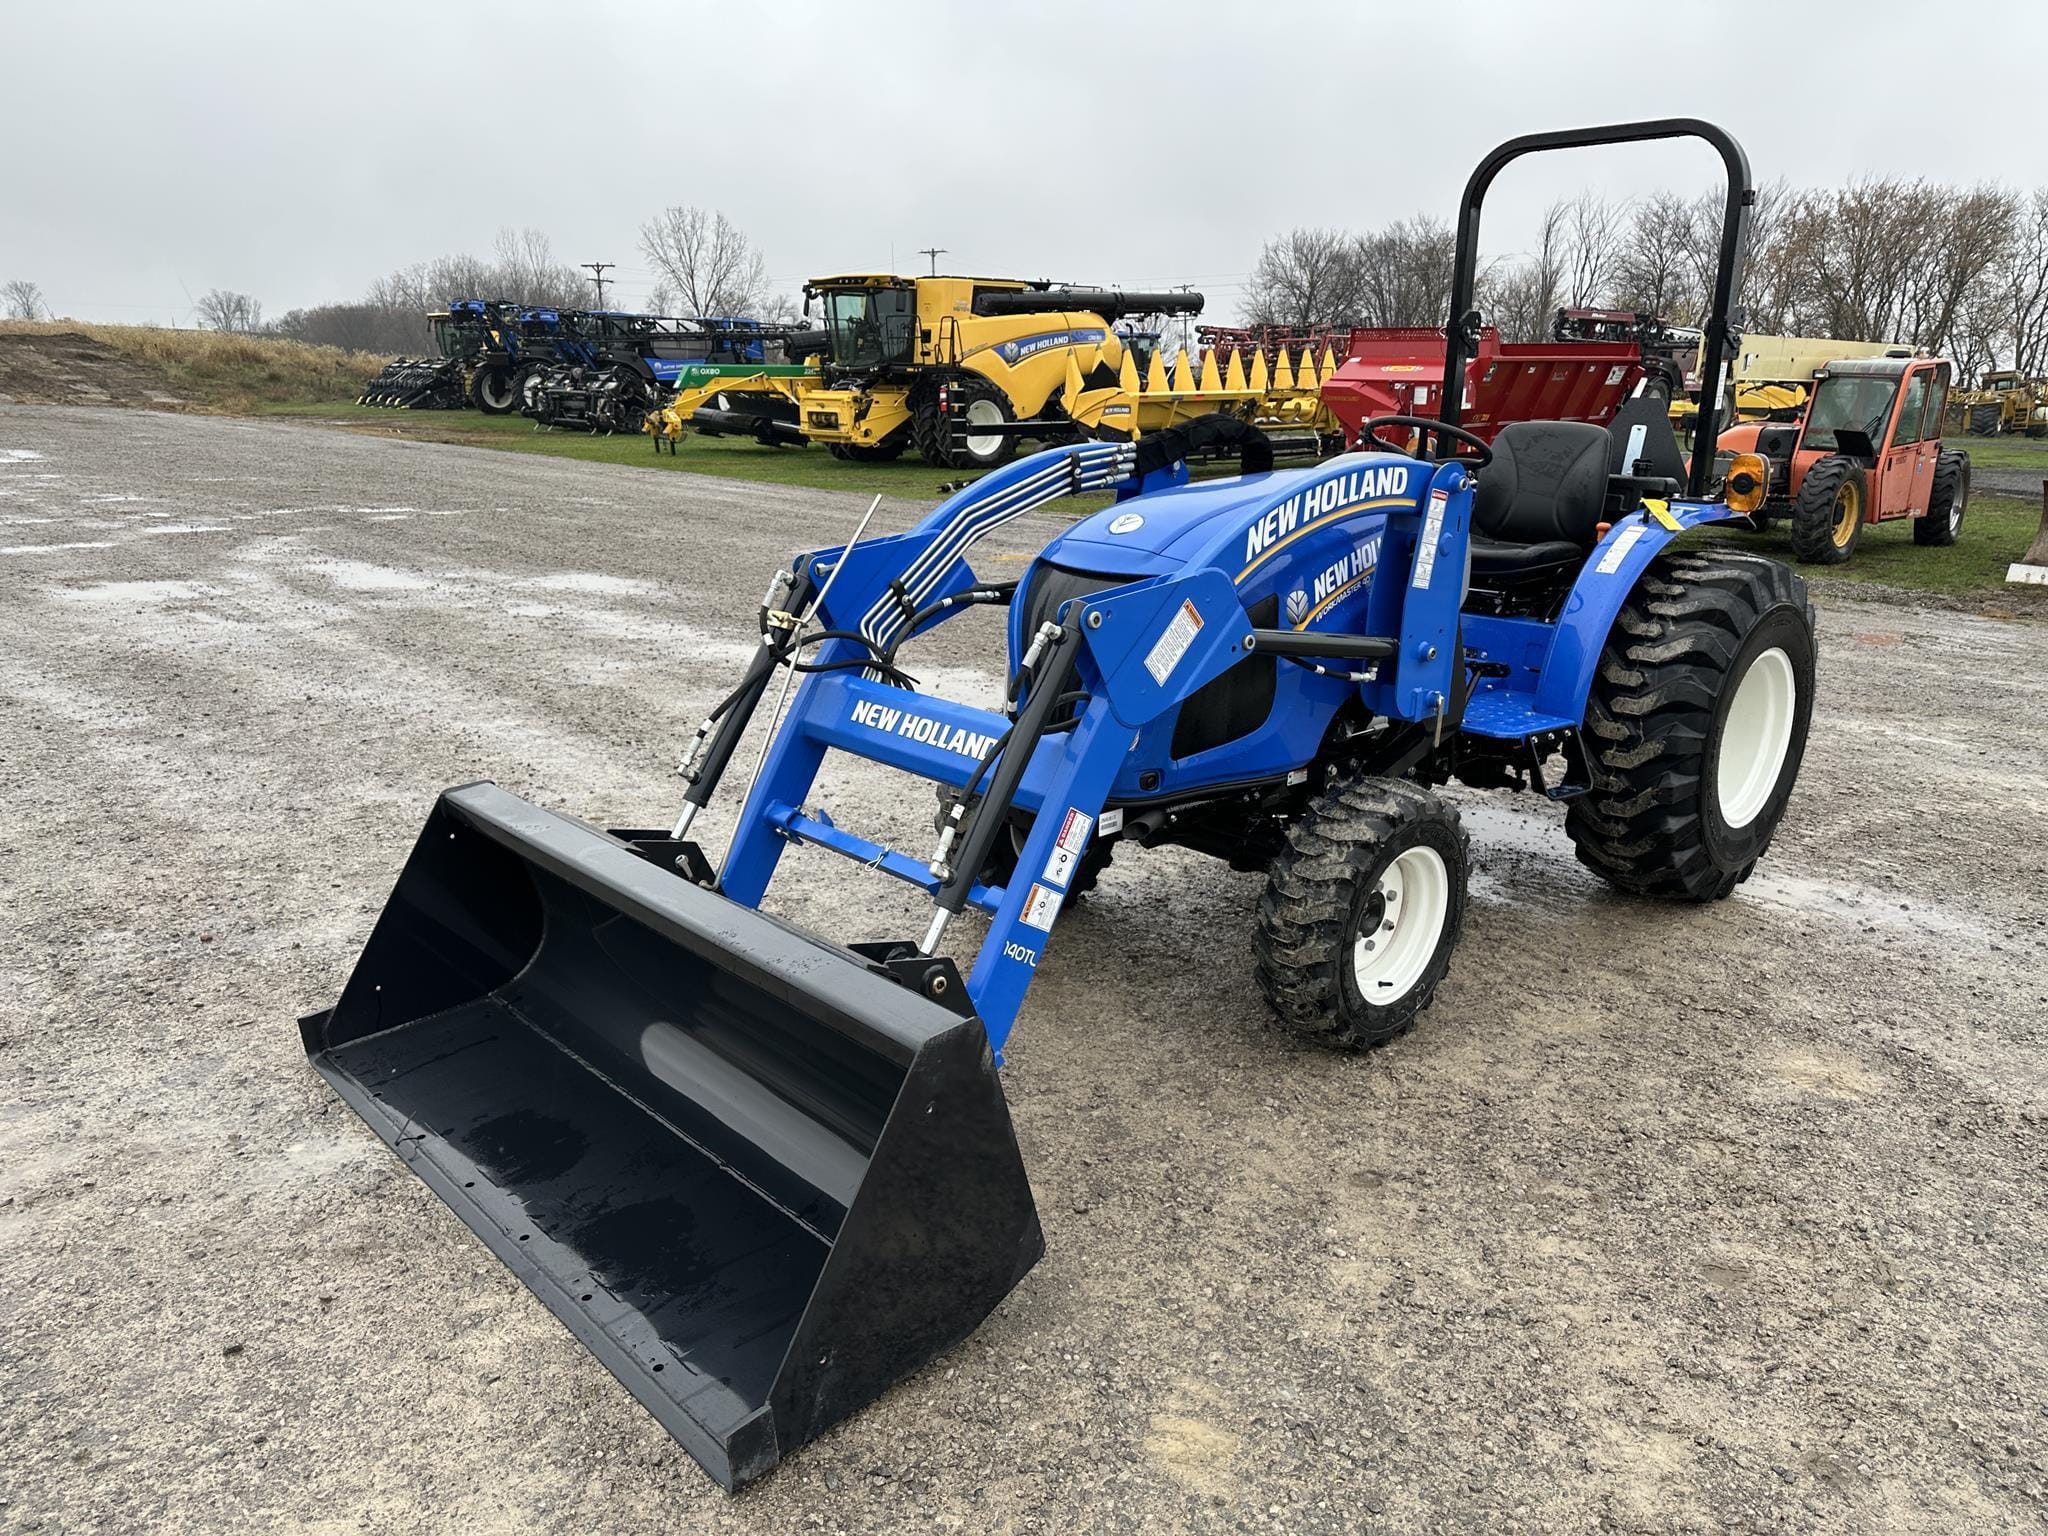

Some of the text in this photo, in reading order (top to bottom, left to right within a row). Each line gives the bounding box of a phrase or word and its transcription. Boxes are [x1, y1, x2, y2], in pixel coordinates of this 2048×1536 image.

[1020, 335, 1069, 356] NEW HOLLAND
[1246, 467, 1408, 563] NEW HOLLAND
[1314, 555, 1349, 604] NEW
[1316, 581, 1361, 622] WORKMASTER
[851, 700, 998, 761] NEW HOLLAND
[1003, 940, 1036, 967] 140TL
